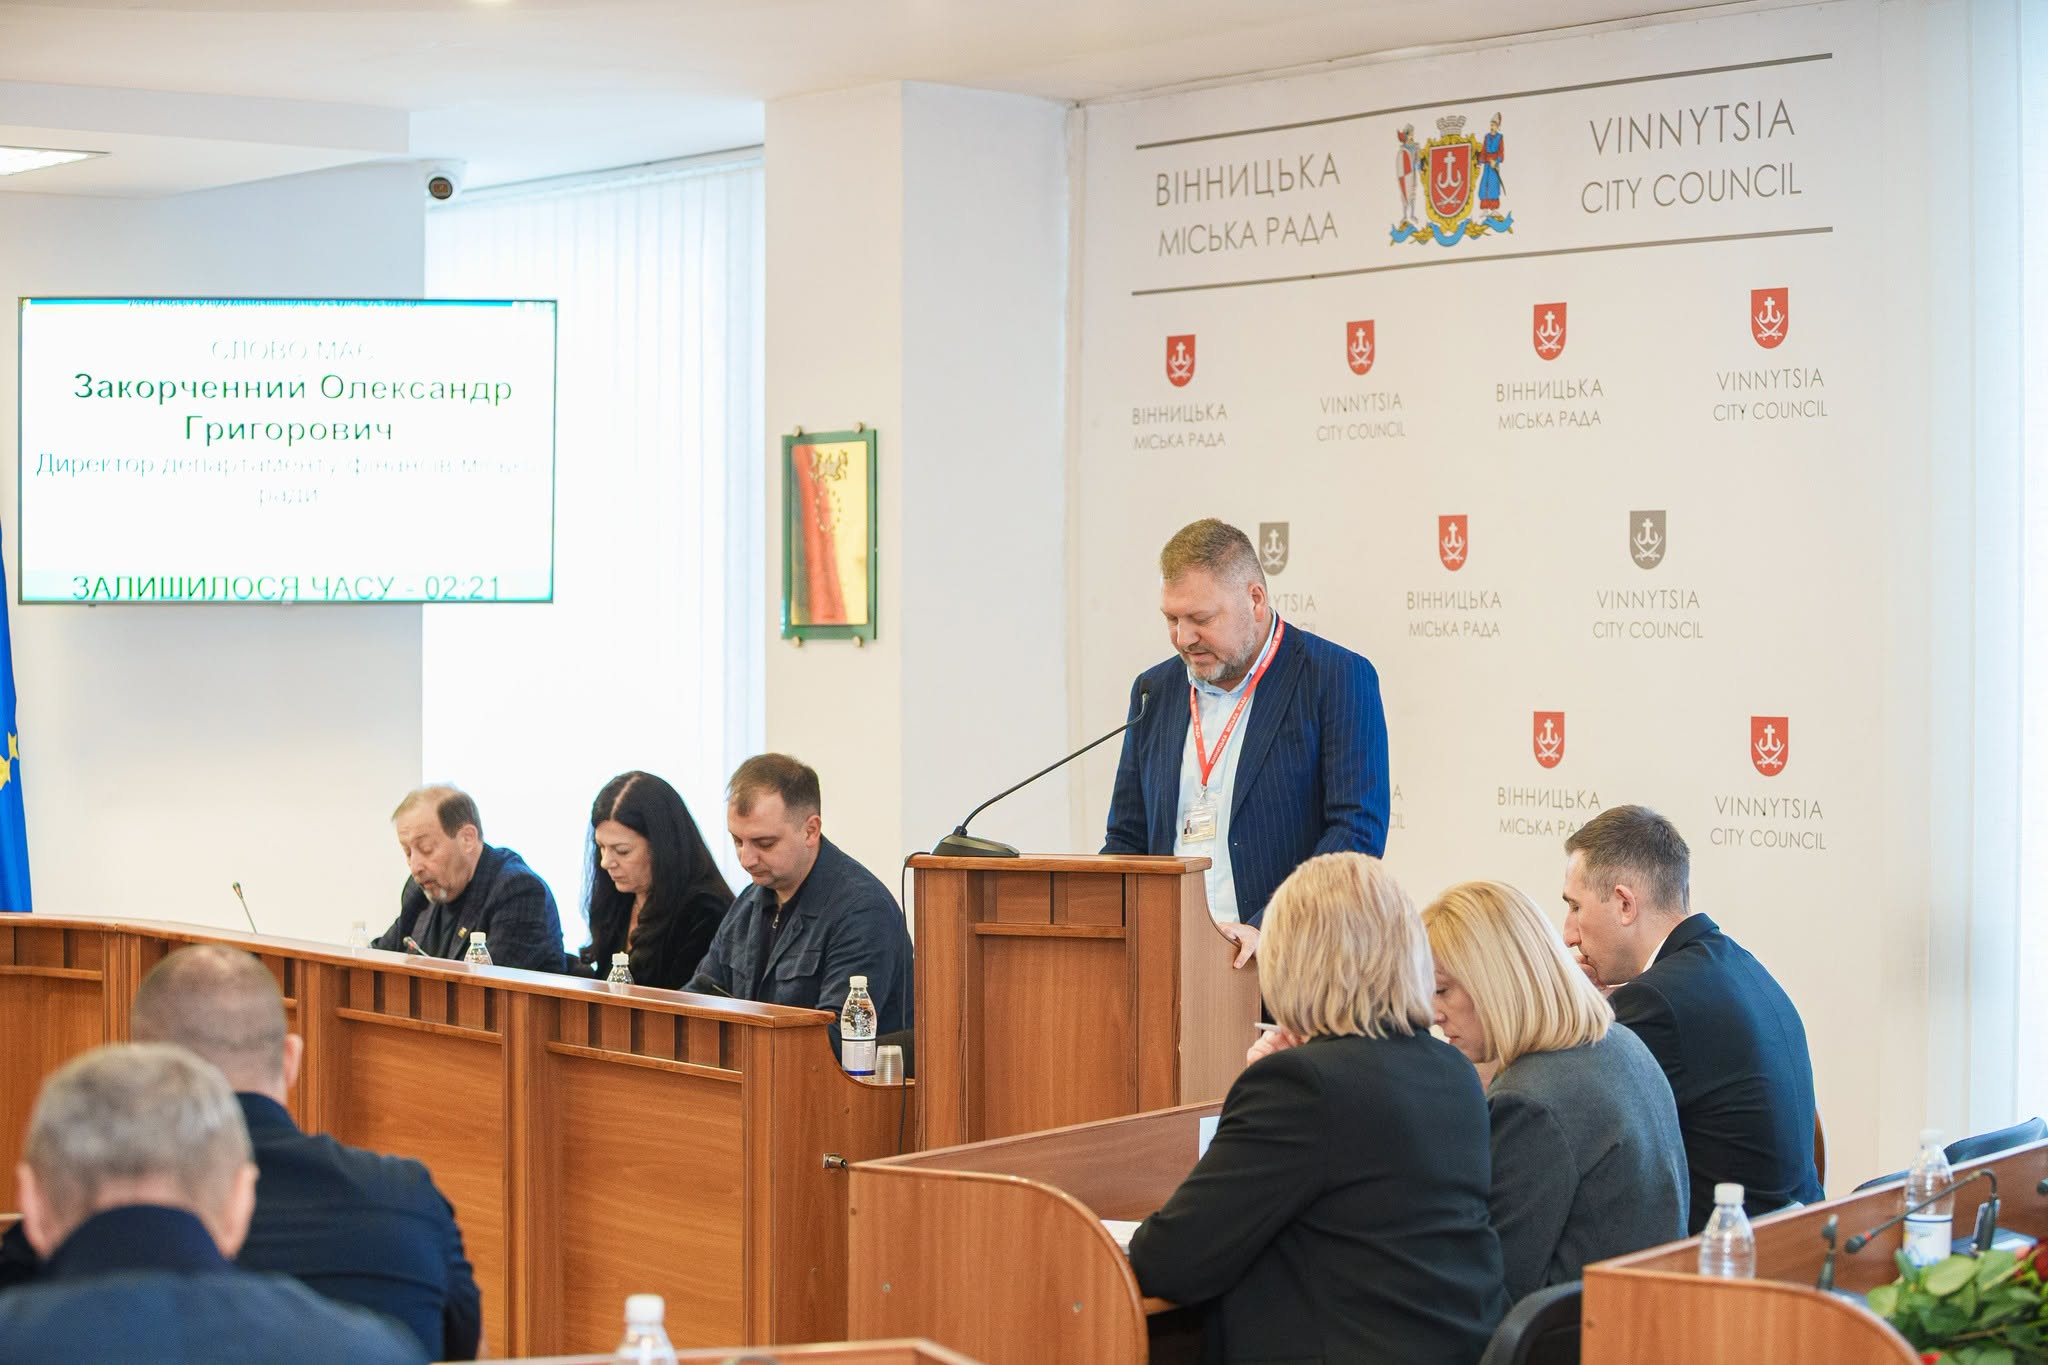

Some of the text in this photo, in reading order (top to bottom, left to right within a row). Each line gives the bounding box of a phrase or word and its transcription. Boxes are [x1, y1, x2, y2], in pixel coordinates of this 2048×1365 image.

[1589, 98, 1796, 157] VINNYTSIA
[1156, 152, 1341, 208] ВІННИЦЬКА
[1580, 161, 1803, 215] CITY COUNCIL
[1158, 210, 1339, 257] МІСЬКА РАДА
[73, 371, 513, 407] Закорченний Олександр
[1495, 378, 1604, 403] ВІННИЦЬКА
[1716, 367, 1825, 393] VINNYTSIA
[1132, 402, 1228, 426] ВІННИЦЬКА
[1319, 391, 1403, 414] VINNYTSIA
[1712, 399, 1829, 422] CITY COUNCIL
[184, 413, 393, 448] Григорович
[1316, 421, 1406, 442] CITY COUNCIL
[1498, 409, 1602, 430] МІСЬКА РАДА
[1134, 431, 1226, 450] МІСЬКА РАДА
[35, 452, 155, 479] Директор
[72, 575, 300, 601] ЗАЛИШИЛОСЯ
[311, 575, 395, 601] ЧАСУ
[424, 575, 499, 601] 02:21
[1596, 588, 1701, 610] VINNYTSIA
[1406, 590, 1503, 612] ВІННИЦЬКА
[1408, 620, 1501, 639] МІСЬКА РАДА
[1592, 620, 1704, 640] CITY COUNCIL
[1497, 786, 1601, 811] ВІННИЦЬКА
[1714, 795, 1824, 820] VINNYTSIA
[1499, 817, 1554, 836] МІСЬКА
[1710, 827, 1827, 851] CITY COUNCIL
